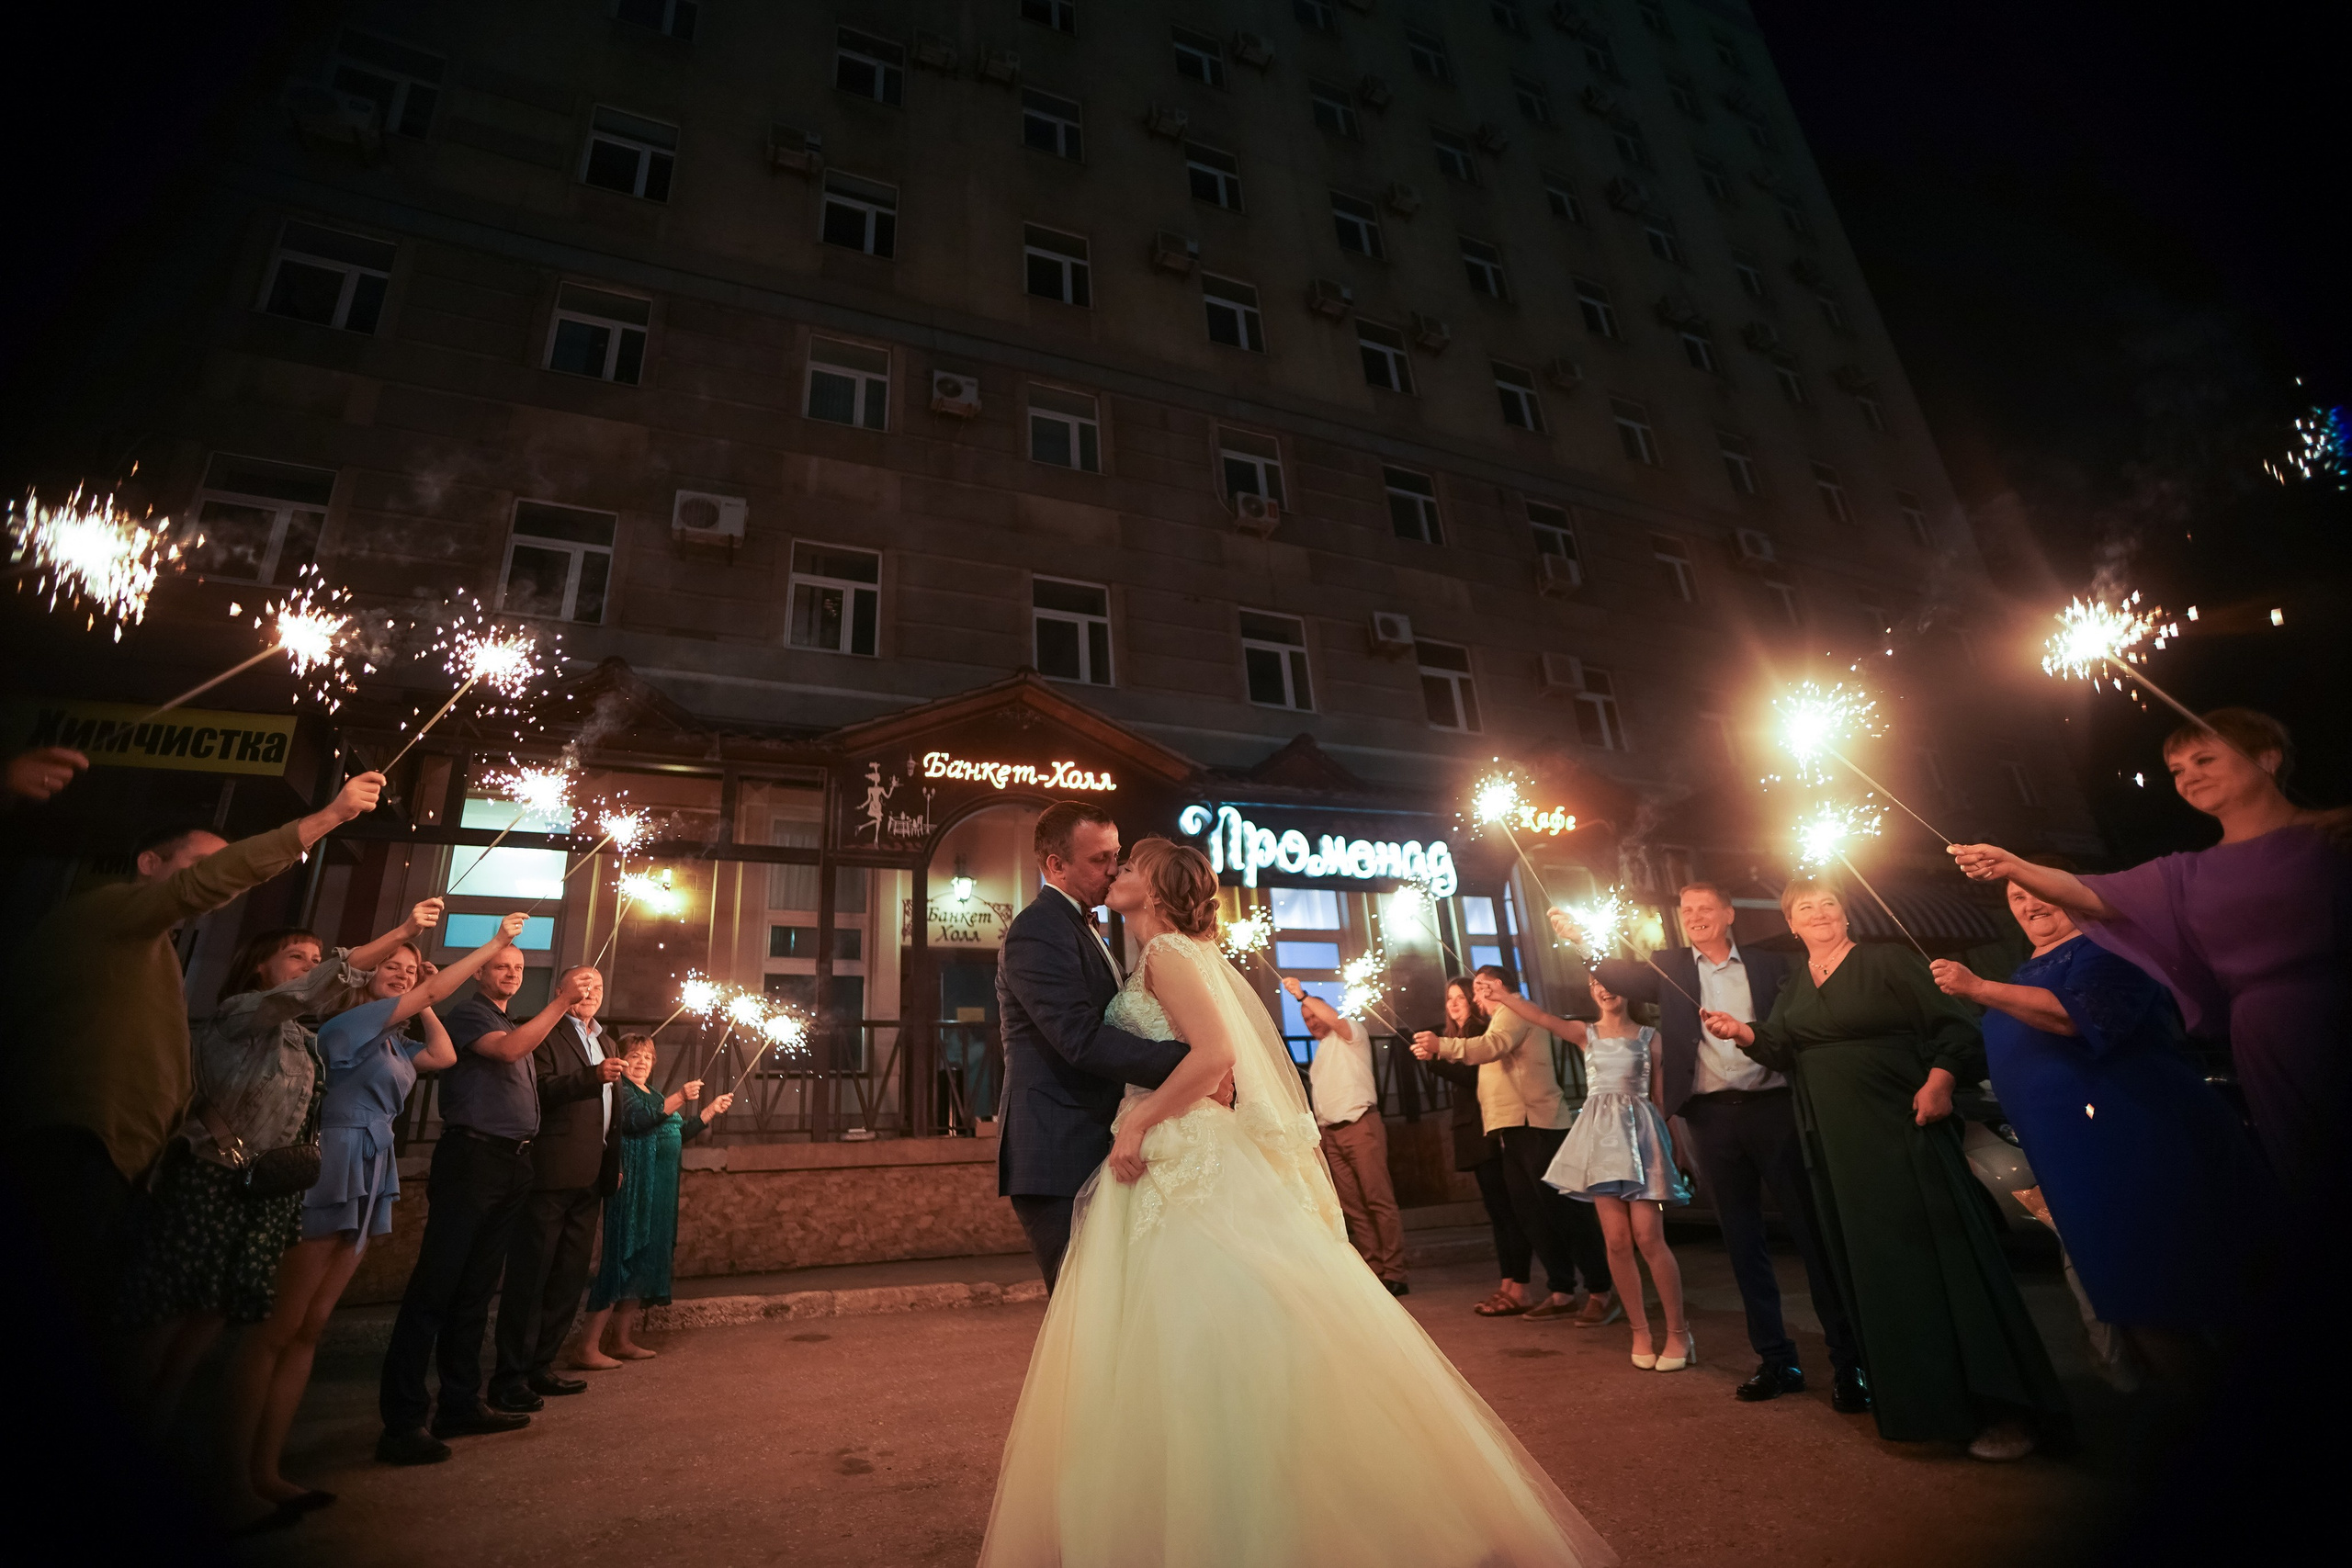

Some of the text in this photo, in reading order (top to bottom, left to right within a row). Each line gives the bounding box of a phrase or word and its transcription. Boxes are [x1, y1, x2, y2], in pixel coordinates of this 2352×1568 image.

[27, 707, 288, 764] Химчистка
[922, 751, 1117, 791] Банкет-Холл
[1517, 805, 1577, 837] Кафе
[1179, 805, 1458, 898] Променад
[926, 906, 993, 928] Банкет
[935, 924, 982, 942] Холл
